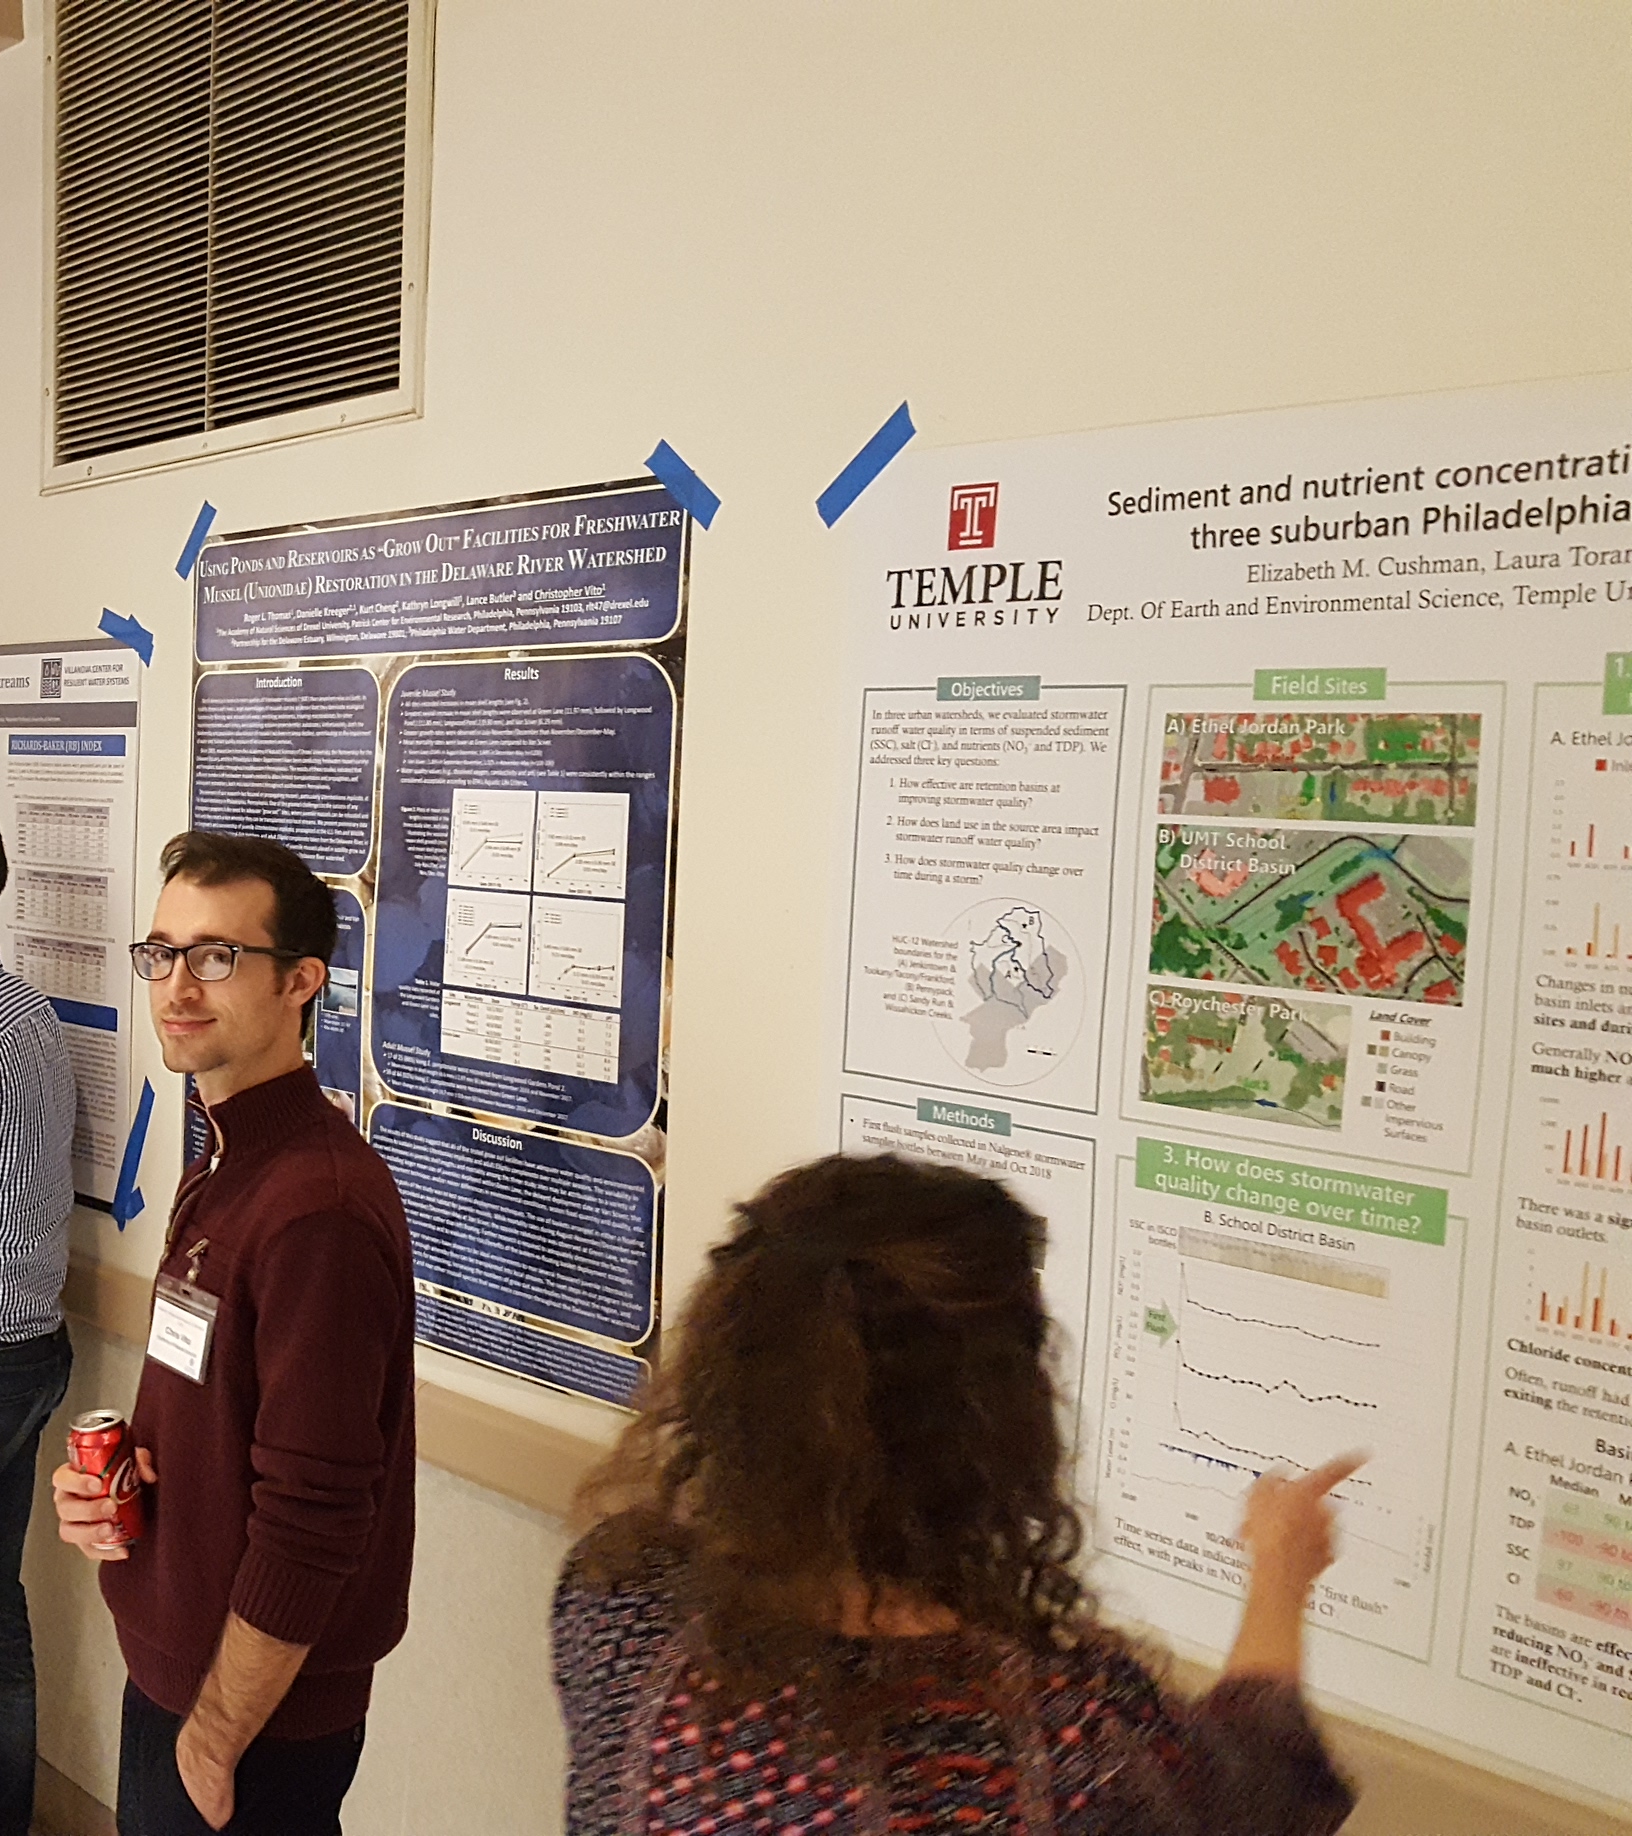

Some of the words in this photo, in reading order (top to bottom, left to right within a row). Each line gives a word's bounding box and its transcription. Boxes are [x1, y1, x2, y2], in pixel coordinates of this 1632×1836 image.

[1107, 485, 1230, 515] Sediment
[1239, 474, 1292, 505] and
[1302, 467, 1424, 498] nutrient
[573, 508, 681, 534] FRESHWATER
[1190, 523, 1260, 549] three
[1270, 512, 1410, 544] suburban
[1422, 494, 1631, 533] Philadelphia
[314, 574, 397, 593] RESTORATION
[440, 561, 514, 582] DELAWARE
[516, 554, 564, 575] RIVER
[567, 546, 667, 569] WATERSHED
[1246, 561, 1336, 583] Elizabeth
[1342, 558, 1369, 578] M.
[1377, 555, 1485, 576] Cushman,
[1494, 550, 1560, 570] Laura
[533, 586, 584, 603] Christopher
[887, 560, 1063, 609] TEMPLE
[1086, 603, 1133, 625] Dept.
[1140, 600, 1166, 619] Of
[1170, 599, 1220, 618] Earth
[1225, 596, 1259, 616] and
[1265, 591, 1411, 614] Environmental
[1418, 588, 1504, 609] Science,
[1513, 583, 1596, 609] Temple
[890, 607, 1060, 630] UNIVERSITY
[256, 677, 303, 689] Introduction
[504, 667, 540, 681] Results
[1271, 675, 1319, 695] Field
[1324, 677, 1368, 695] Sites
[950, 682, 1024, 699] Objectives
[872, 709, 882, 720] In
[884, 709, 906, 720] three
[907, 709, 932, 720] urban
[987, 711, 1001, 719] we
[1002, 708, 1048, 720] evaluated
[1050, 711, 1108, 720] stormwater
[870, 723, 900, 735] runoff
[901, 726, 925, 735] water
[926, 724, 956, 737] quality
[958, 727, 968, 735] in
[969, 726, 996, 735] terms
[996, 724, 1009, 735] of
[1010, 724, 1061, 738] suspended
[1062, 725, 1110, 736] sediment
[1166, 719, 1186, 736] A)
[1191, 718, 1236, 735] Ethel
[1239, 718, 1301, 735] Jordan
[1304, 718, 1346, 735] Park
[80, 740, 103, 751] INDEX
[1572, 731, 1611, 746] Ethel
[898, 777, 920, 788] How
[920, 778, 957, 789] effective
[958, 782, 974, 790] are
[975, 782, 1017, 791] retention
[1018, 780, 1048, 793] basins
[1050, 784, 1061, 793] at
[896, 815, 918, 826] How
[919, 816, 940, 828] does
[941, 817, 961, 829] land
[963, 821, 979, 830] use
[980, 822, 990, 831] in
[992, 820, 1007, 831] the
[1008, 823, 1040, 833] source
[1041, 825, 1062, 834] area
[1064, 826, 1099, 838] impact
[1158, 828, 1176, 847] B)
[1181, 831, 1220, 847] UMT
[1225, 831, 1286, 850] School
[894, 853, 916, 864] How
[917, 855, 937, 866] does
[938, 859, 990, 870] stormwater
[991, 861, 1024, 875] quality
[1025, 862, 1060, 877] change
[1062, 867, 1084, 876] over
[1179, 853, 1243, 869] District
[1247, 858, 1297, 876] Basin
[1148, 990, 1166, 1009] C)
[1171, 991, 1265, 1018] Roychester
[1269, 1003, 1308, 1023] Park
[1369, 1010, 1398, 1022] Land
[1399, 1013, 1433, 1027] Cover
[1533, 1012, 1566, 1028] sites
[1570, 1018, 1597, 1031] and
[1390, 1065, 1419, 1077] Grass
[1531, 1062, 1570, 1078] much
[1574, 1065, 1622, 1084] higher
[932, 1105, 995, 1129] Methods
[473, 1128, 523, 1150] Discussion
[1162, 1144, 1179, 1165] 3.
[1184, 1149, 1230, 1173] How
[1235, 1159, 1285, 1183] does
[1290, 1171, 1414, 1205] stormwater
[1154, 1172, 1221, 1199] quality
[1225, 1185, 1300, 1216] change
[1304, 1201, 1355, 1223] over
[1360, 1207, 1422, 1234] time?
[1203, 1210, 1216, 1223] B.
[1218, 1213, 1263, 1233] School
[1266, 1222, 1314, 1244] District
[1318, 1232, 1355, 1250] Basin
[1507, 1337, 1571, 1364] Chloride
[1568, 1457, 1623, 1485] Jordan
[1549, 1474, 1600, 1498] Median
[1509, 1514, 1536, 1531] TDP
[1506, 1542, 1531, 1561] SSC
